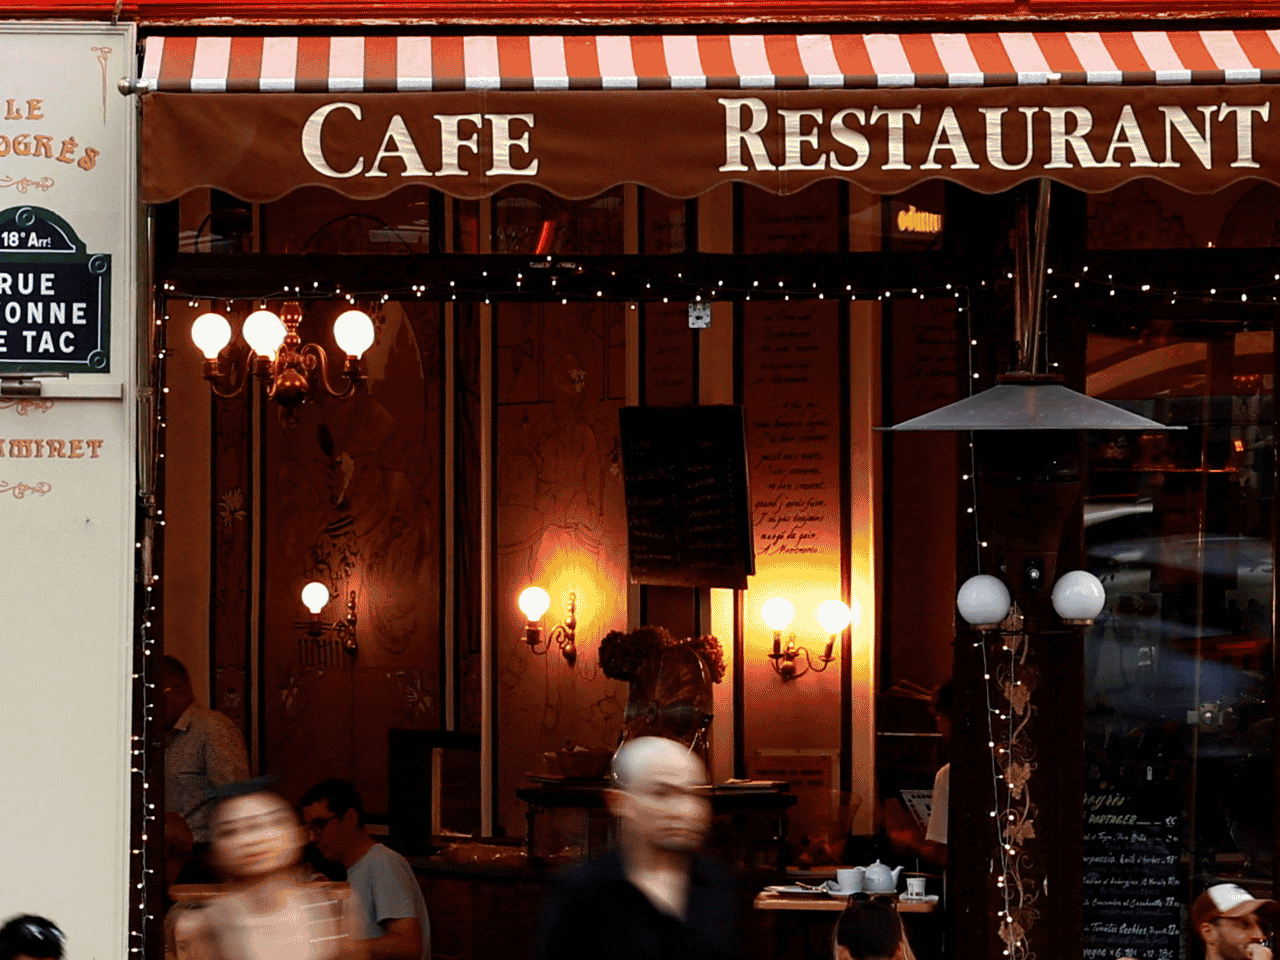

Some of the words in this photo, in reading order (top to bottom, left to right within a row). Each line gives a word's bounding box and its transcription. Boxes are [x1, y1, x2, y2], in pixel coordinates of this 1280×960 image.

[4, 98, 44, 120] LE
[301, 101, 539, 178] CAFE
[718, 96, 1270, 173] RESTAURANT
[22, 331, 75, 353] TAC
[1088, 815, 1137, 826] PARTAGER
